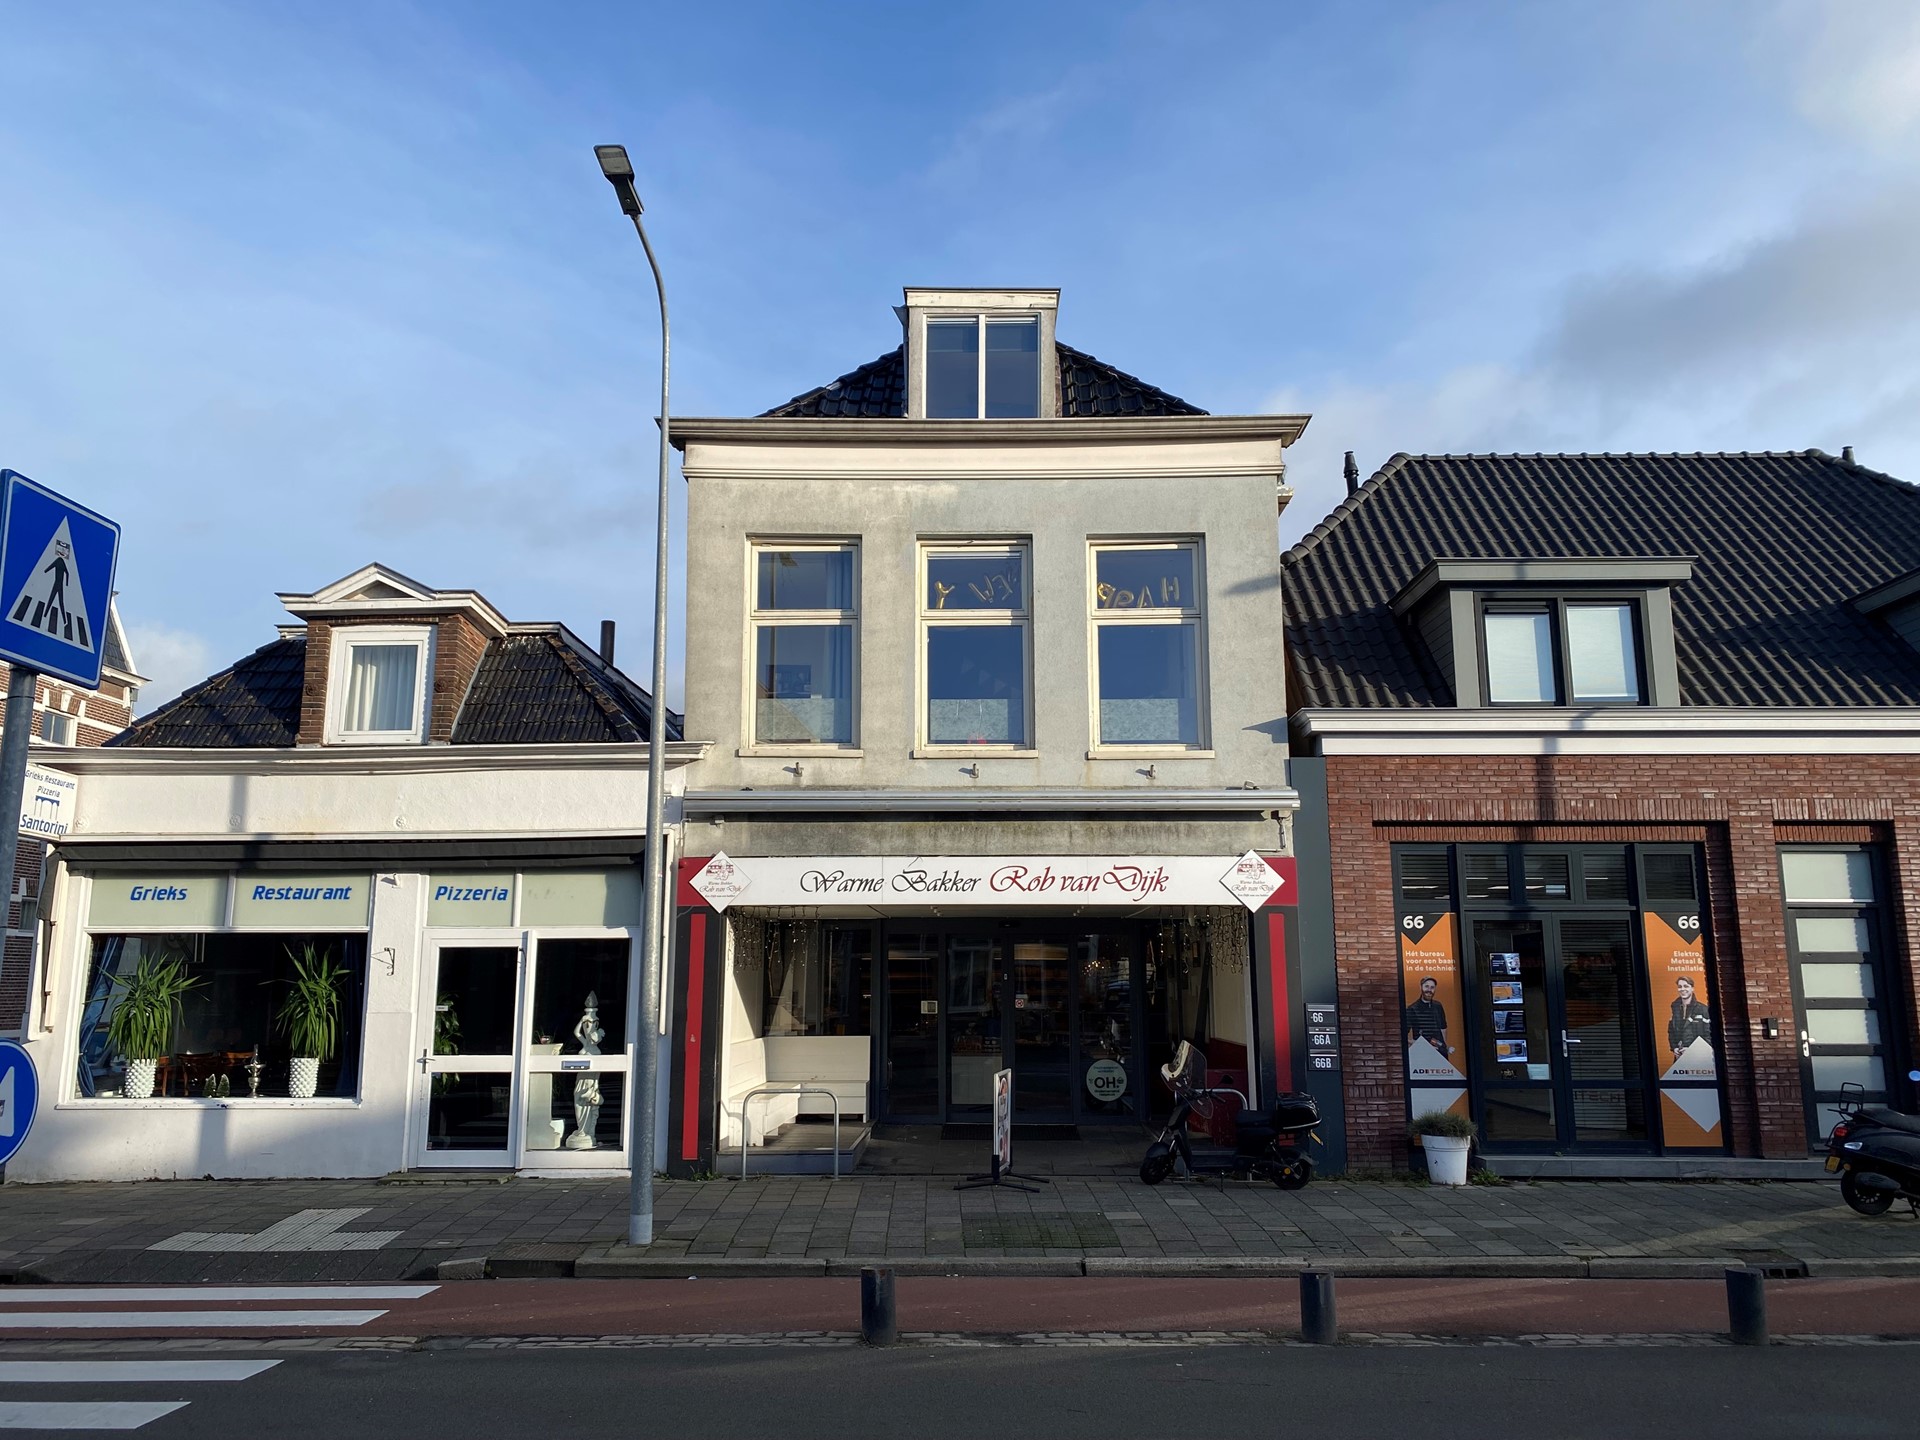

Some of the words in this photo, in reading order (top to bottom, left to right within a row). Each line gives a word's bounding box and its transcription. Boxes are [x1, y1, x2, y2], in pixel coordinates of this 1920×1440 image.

[25, 769, 44, 782] Grieks
[44, 775, 75, 790] Restaurant
[37, 785, 60, 798] Pizzeria
[20, 814, 68, 835] Santorini
[800, 870, 884, 893] Warme
[892, 869, 981, 893] Bakker
[990, 865, 1056, 892] Rob
[1060, 875, 1100, 892] van
[1103, 864, 1169, 902] Dijk
[130, 886, 187, 901] Grieks
[252, 885, 352, 900] Restaurant
[434, 886, 509, 901] Pizzeria
[1403, 915, 1425, 929] 66
[1678, 915, 1700, 930] 66
[1312, 1012, 1324, 1023] 66
[1314, 1034, 1331, 1045] 66A
[1315, 1057, 1332, 1068] 66B
